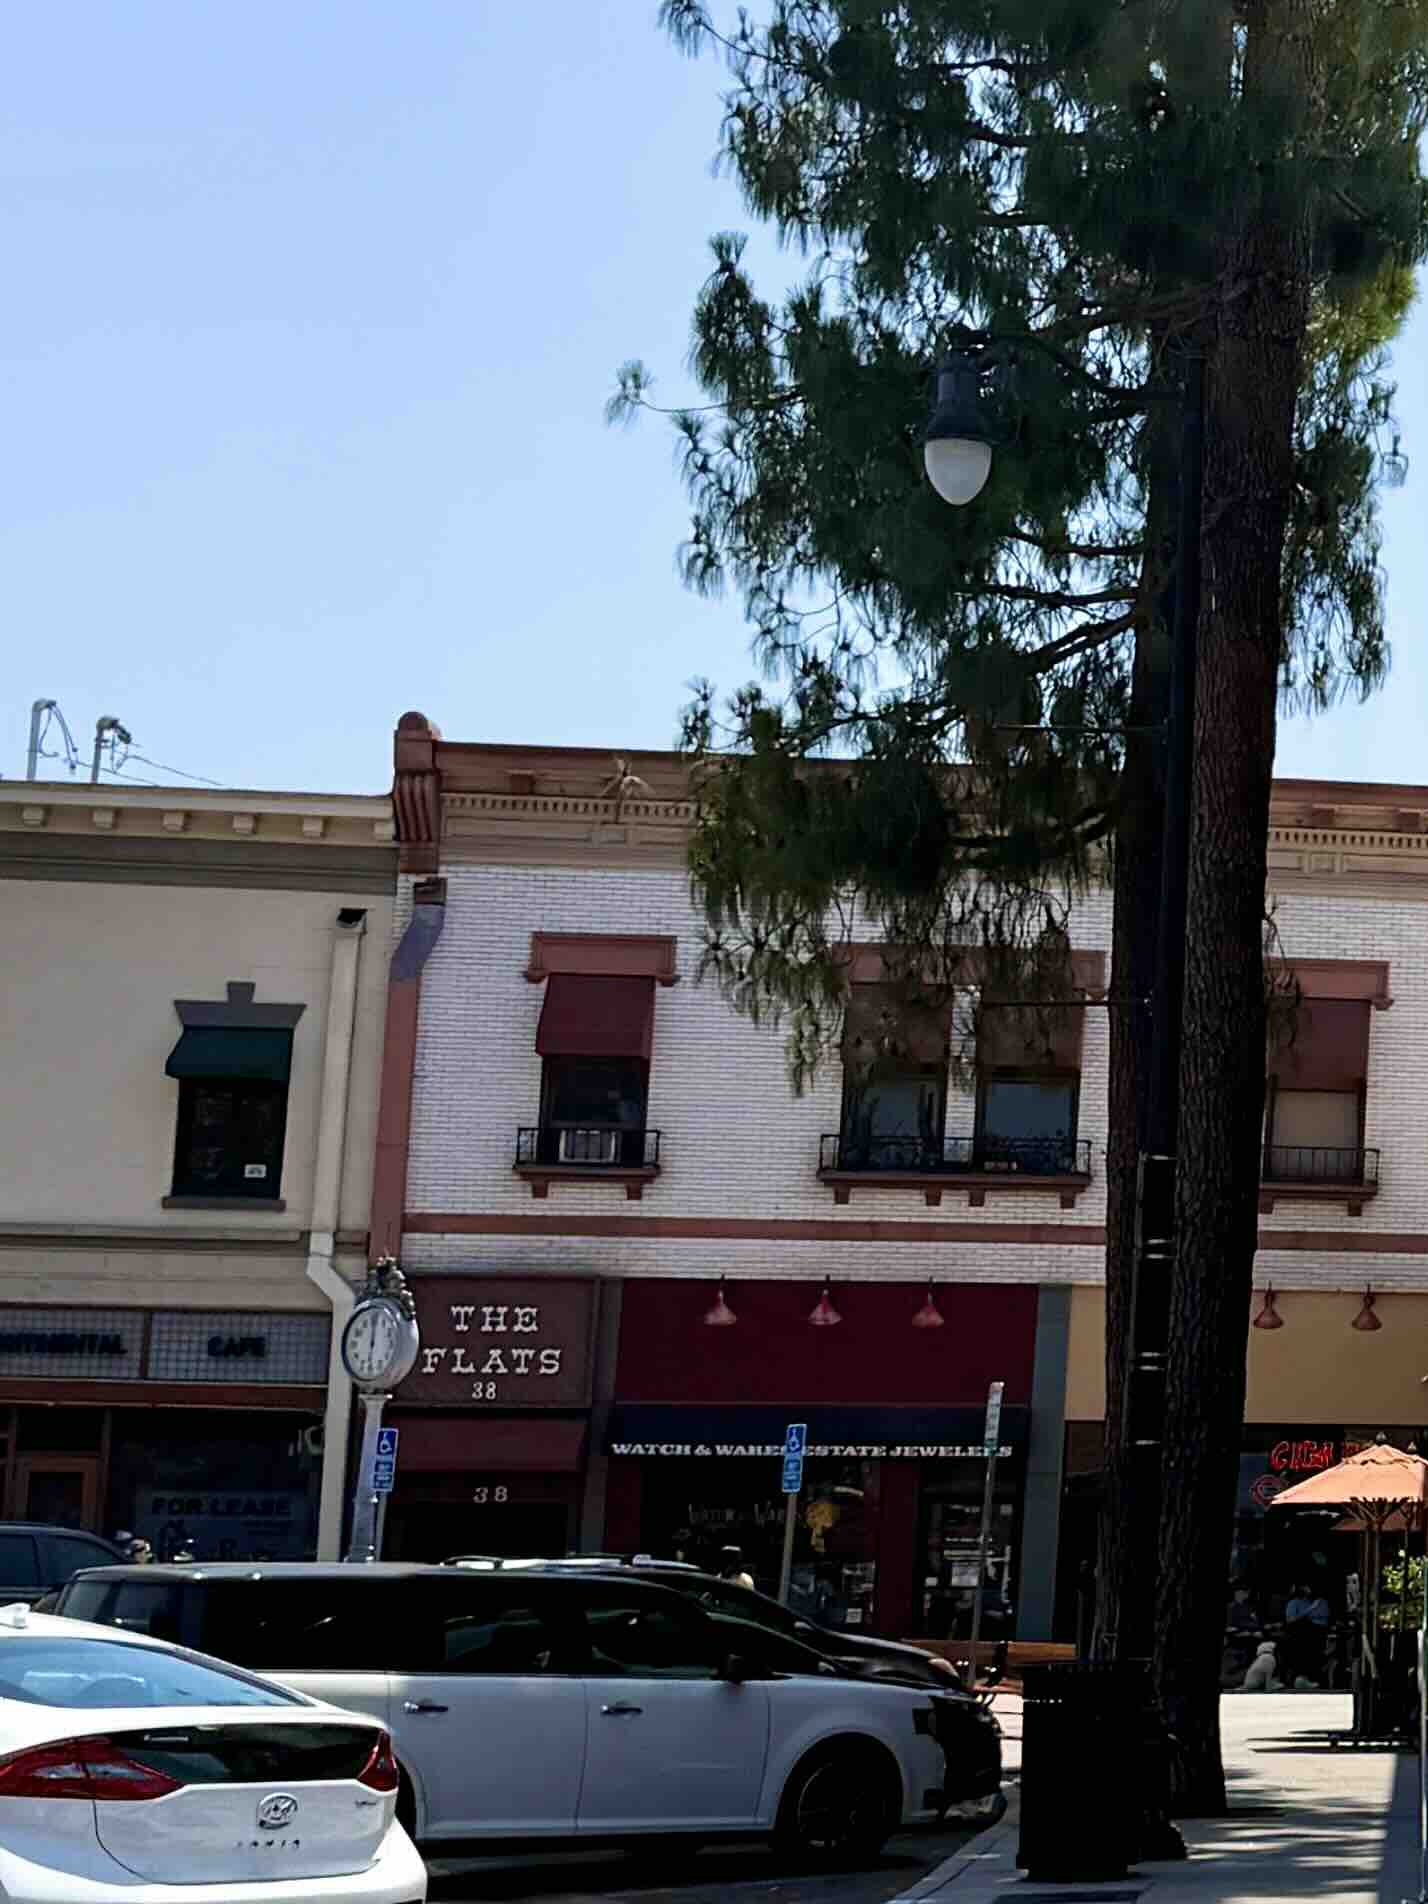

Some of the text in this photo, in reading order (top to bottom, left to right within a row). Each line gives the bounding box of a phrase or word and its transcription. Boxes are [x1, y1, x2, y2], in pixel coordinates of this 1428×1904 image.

[451, 1305, 539, 1332] THE
[421, 1348, 561, 1375] FLATS
[471, 1382, 497, 1400] 38
[612, 1443, 692, 1457] WATCH
[694, 1444, 713, 1457] &
[804, 1445, 887, 1457] ESTATE
[473, 1485, 508, 1504] 38
[152, 1497, 292, 1517] FOR LEASE
